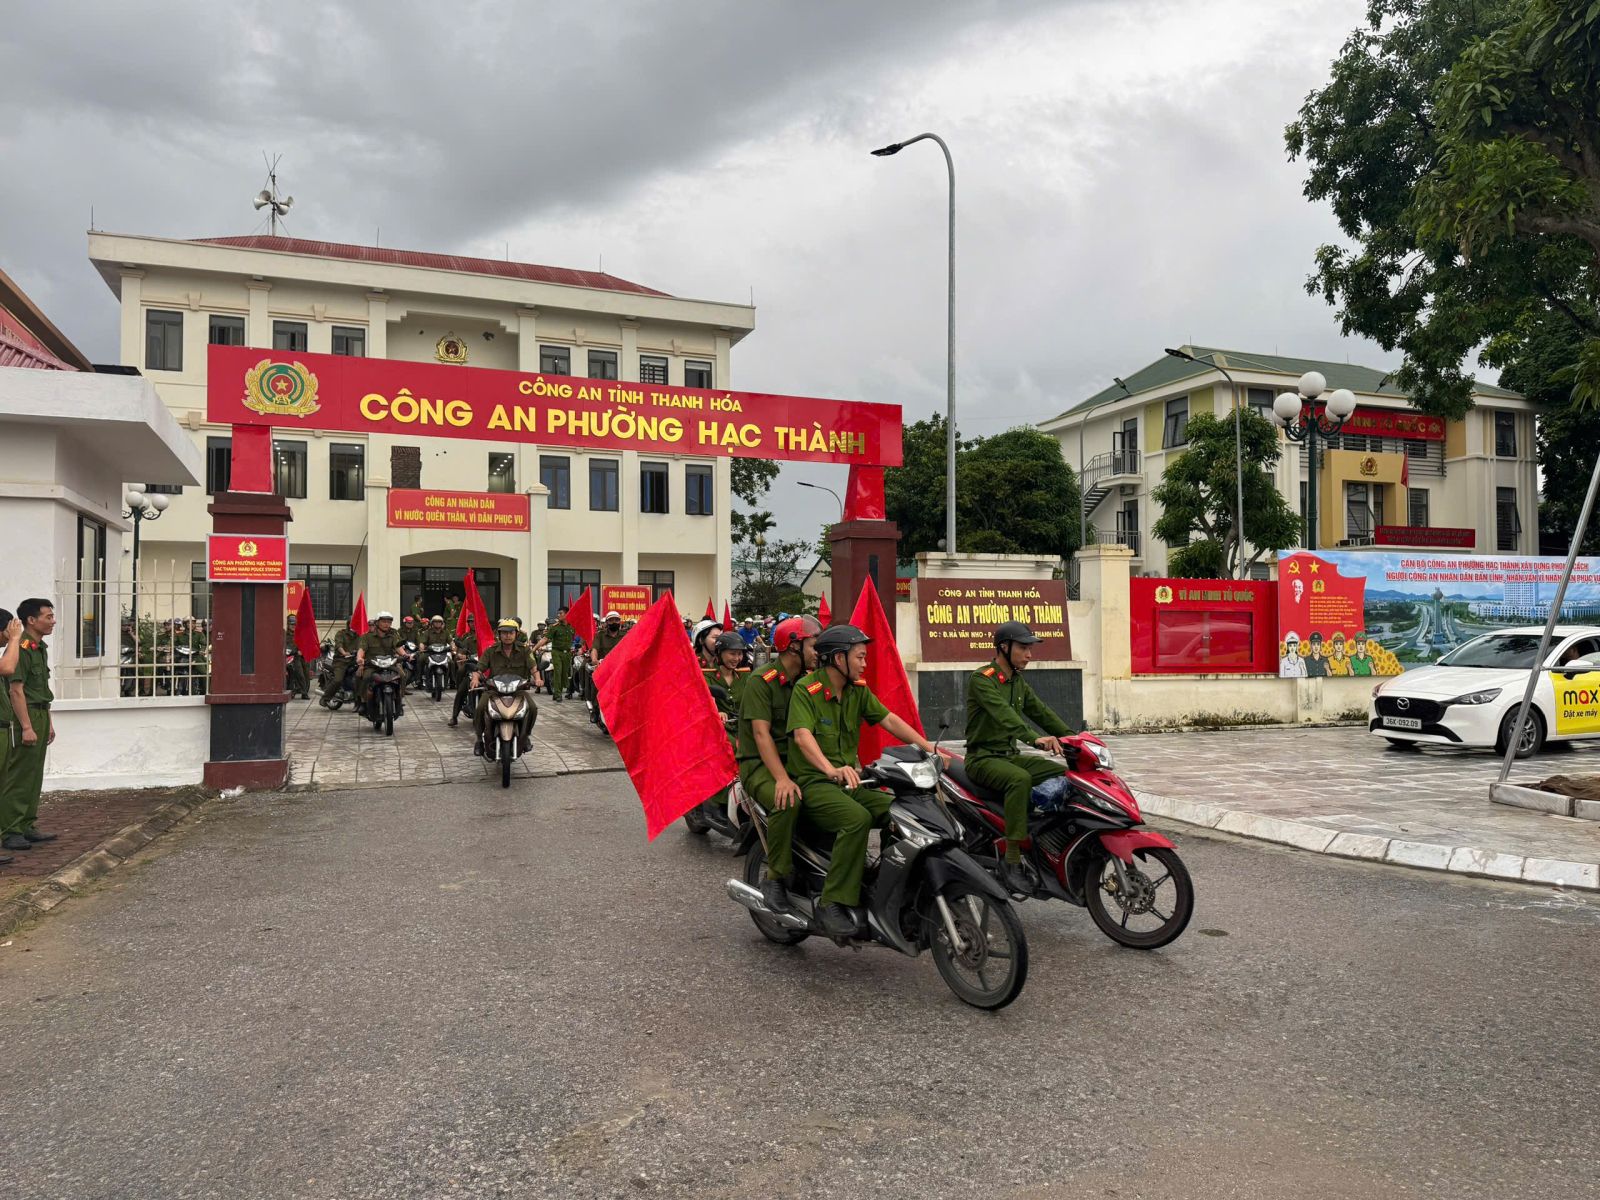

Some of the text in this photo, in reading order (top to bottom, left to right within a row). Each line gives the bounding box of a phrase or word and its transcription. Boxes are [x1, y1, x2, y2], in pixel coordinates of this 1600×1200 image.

[518, 377, 743, 413] CÔNG AN TỈNH THANH HÓA
[359, 388, 866, 455] CÔNG AN PHƯỜNG HẠC THÀNH
[425, 495, 495, 509] CÔNG AN NHÂN DÂN
[395, 508, 403, 520] VÌ
[404, 509, 424, 521] NƯỚC
[426, 509, 445, 522] QUÊN
[469, 511, 477, 523] VÌ
[478, 511, 493, 524] DÂN
[494, 513, 512, 526] PHỤC
[514, 514, 524, 526] VỤ
[938, 586, 1041, 599] CÔNG AN TỈNH THANH HÓA
[927, 600, 953, 624] CÔNG
[957, 605, 971, 624] AN
[973, 599, 1010, 624] PHƯỜNG
[1033, 601, 1063, 624] THÀNH
[1563, 688, 1600, 706] max
